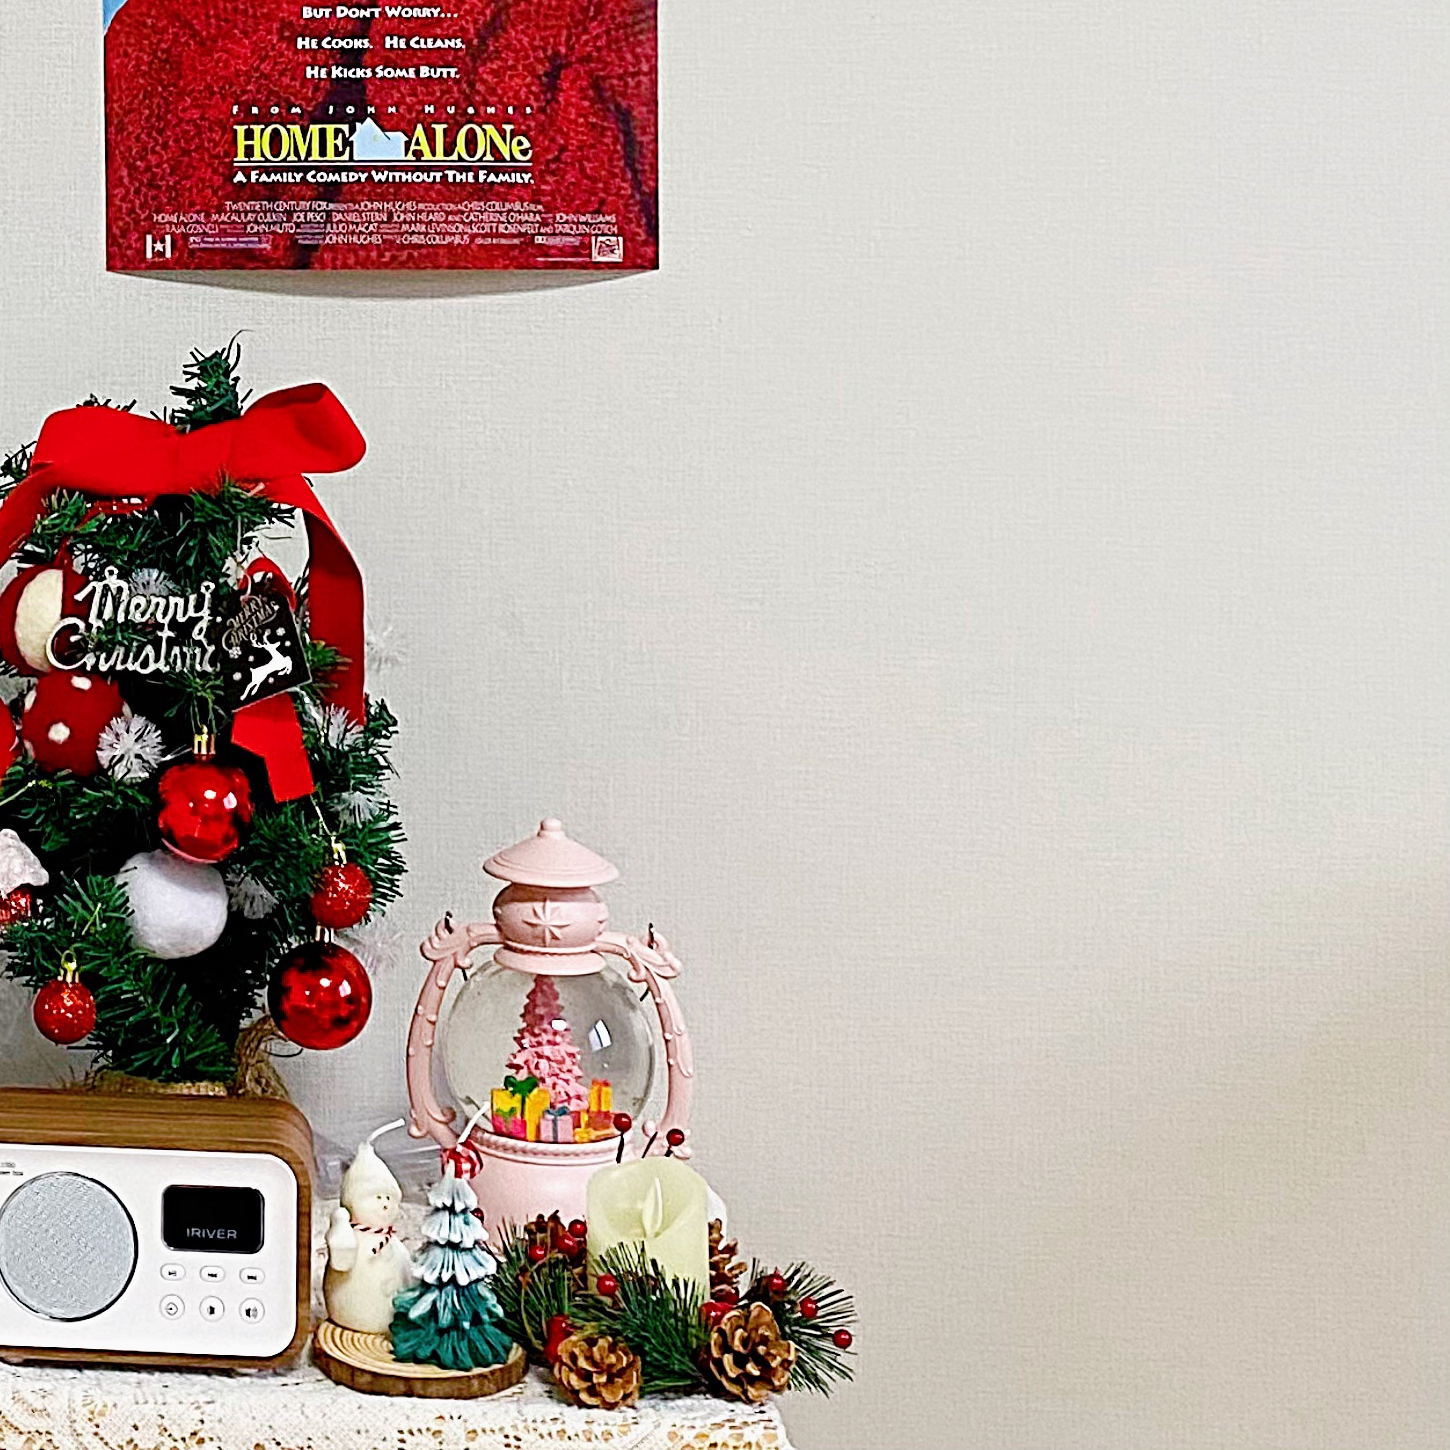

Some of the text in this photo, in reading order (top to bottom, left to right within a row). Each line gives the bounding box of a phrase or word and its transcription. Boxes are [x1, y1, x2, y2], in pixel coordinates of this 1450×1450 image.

[302, 6, 332, 19] BUT
[384, 5, 459, 19] WORRY...
[296, 35, 466, 50] HE COOKS. HE CLEANS.
[305, 65, 461, 79] HE KICKS SOME BUTT.
[232, 104, 533, 115] FROM JOHN HUGHES
[232, 123, 350, 162] HOME
[233, 170, 535, 184] A FAMILY COMEDY WITHOUT THE FAMILY.
[74, 566, 217, 642] Merry
[186, 1227, 238, 1240] IRIVER
